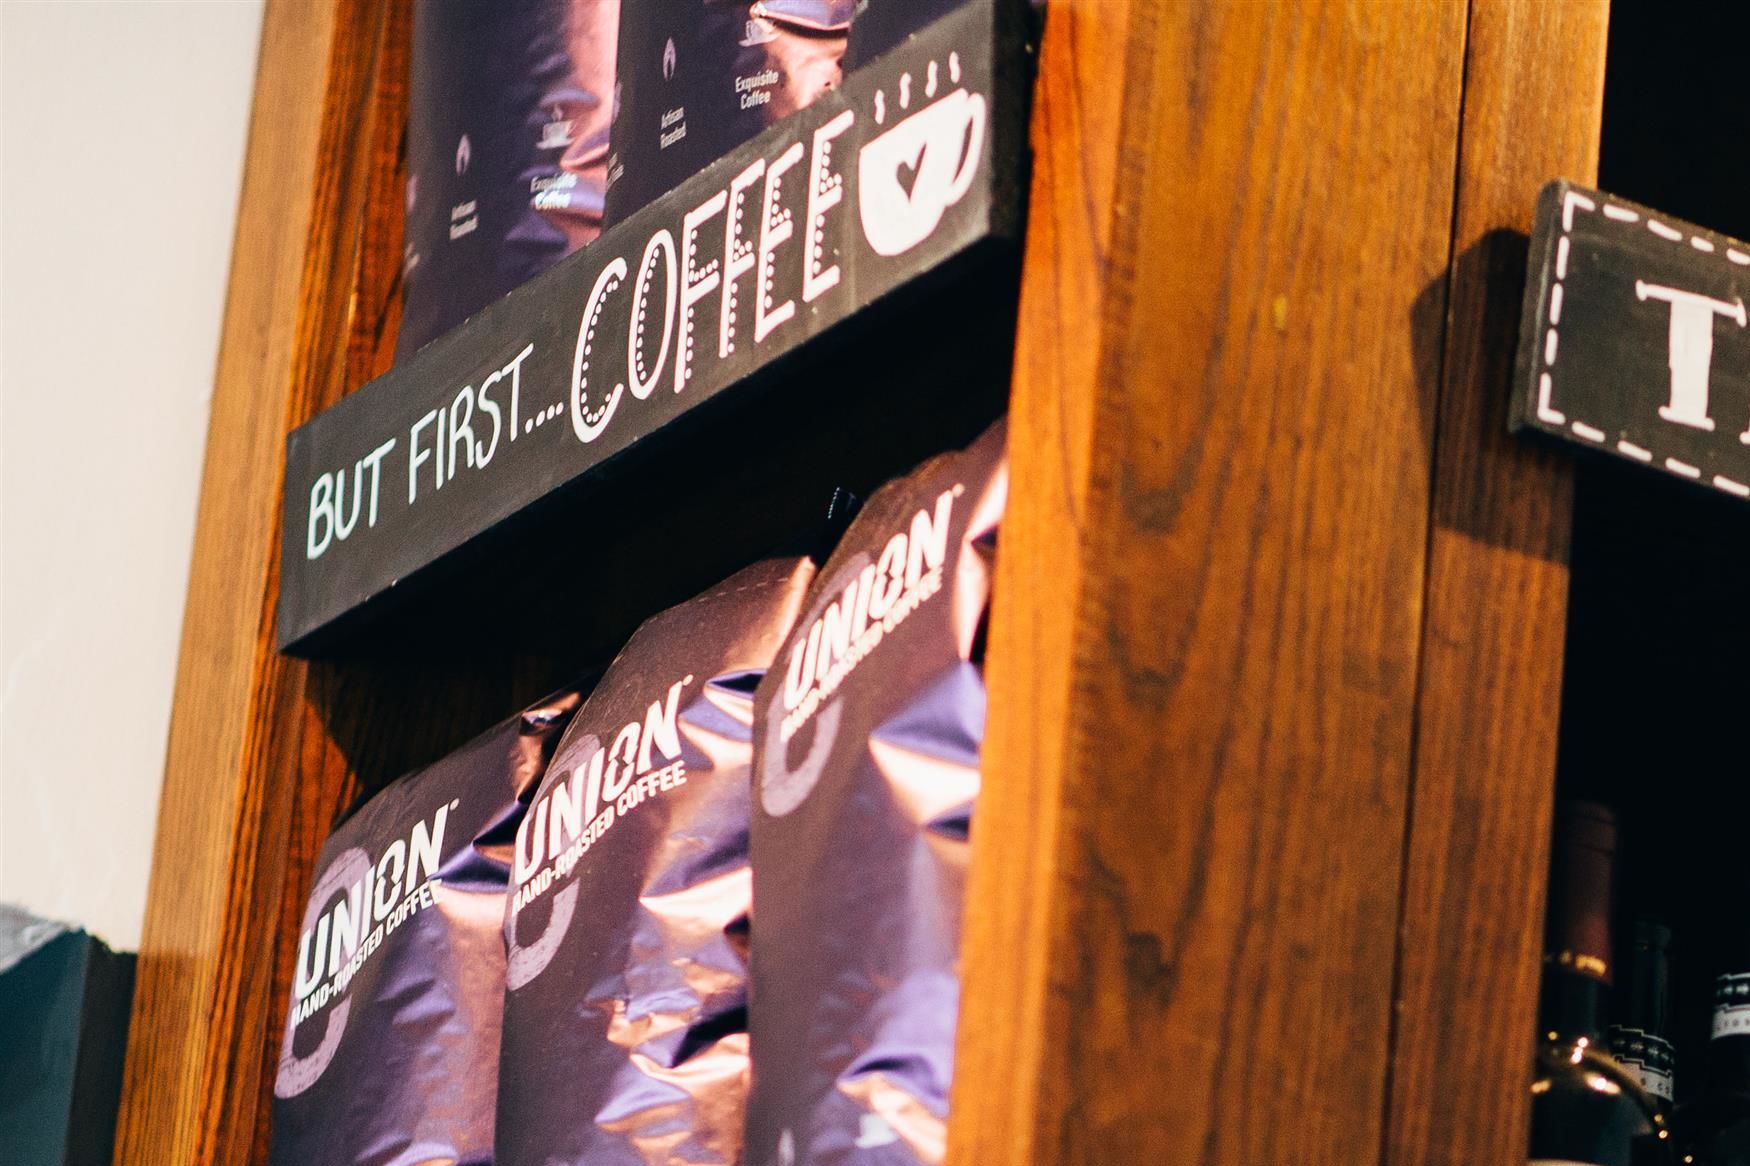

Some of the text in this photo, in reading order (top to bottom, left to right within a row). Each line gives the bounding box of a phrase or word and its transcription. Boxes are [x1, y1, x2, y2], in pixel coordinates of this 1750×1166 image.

[736, 70, 779, 93] Exquisite
[740, 89, 770, 110] Coffee
[307, 438, 397, 560] BUT
[572, 110, 855, 443] COFFEE
[784, 489, 953, 710] UNION
[515, 680, 683, 885] UNION
[616, 759, 688, 817] COFFEE
[295, 802, 450, 1000] UNION
[386, 878, 443, 936] COFFEE
